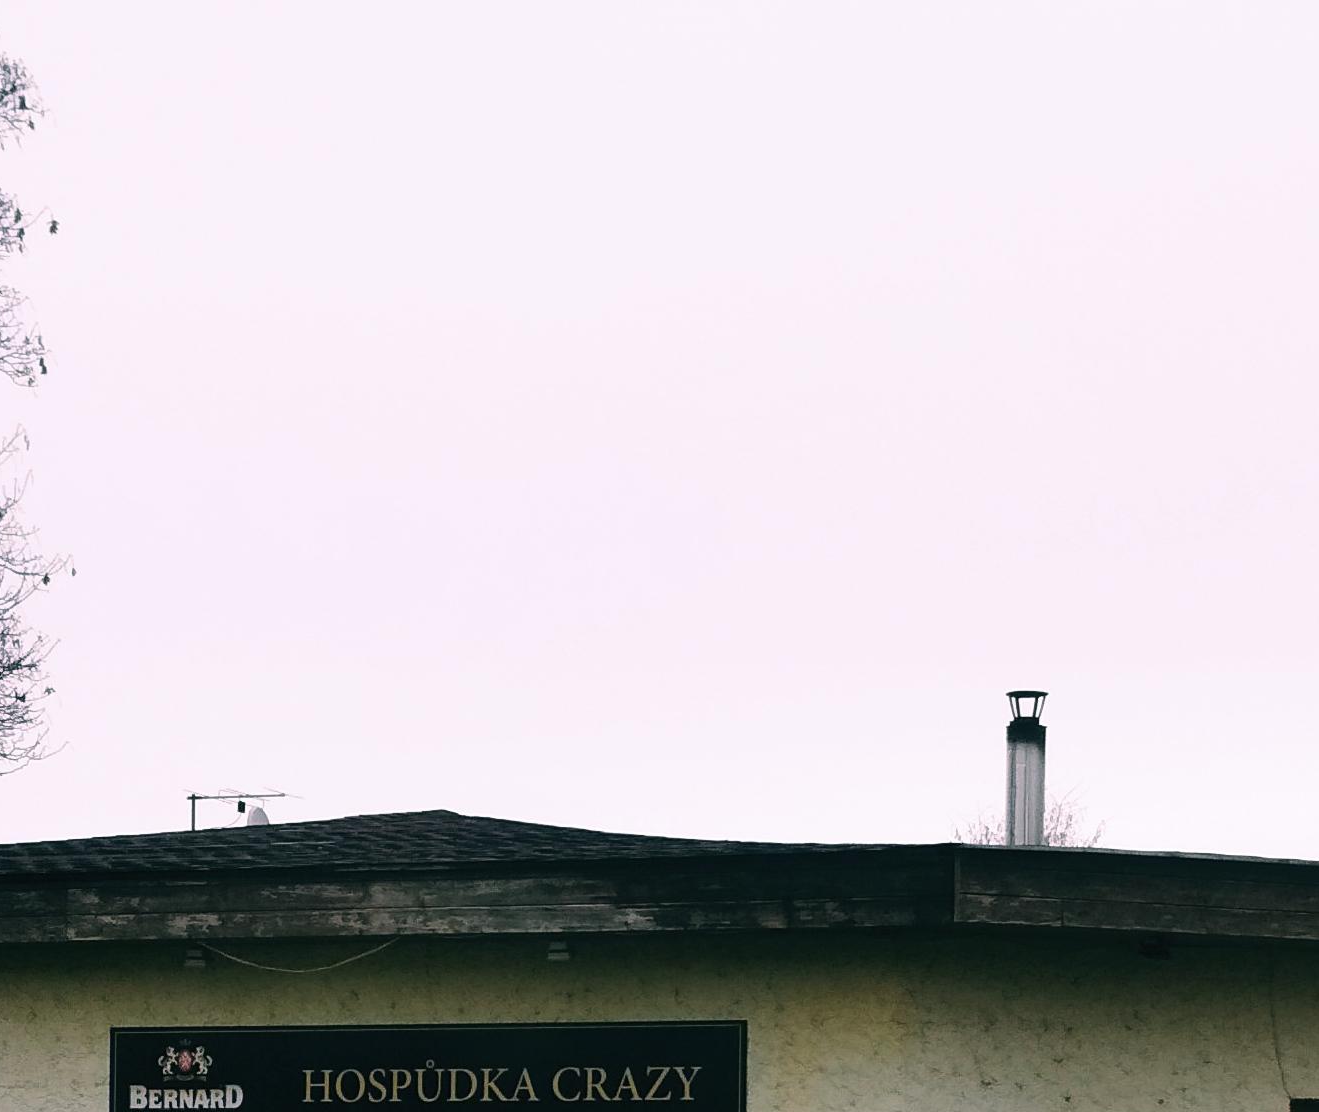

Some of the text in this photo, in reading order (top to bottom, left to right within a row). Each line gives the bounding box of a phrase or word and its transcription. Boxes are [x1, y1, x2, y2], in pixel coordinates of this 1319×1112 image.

[129, 1084, 243, 1110] BERNARD
[302, 1059, 702, 1104] HOSPŮDKA CRAZY
